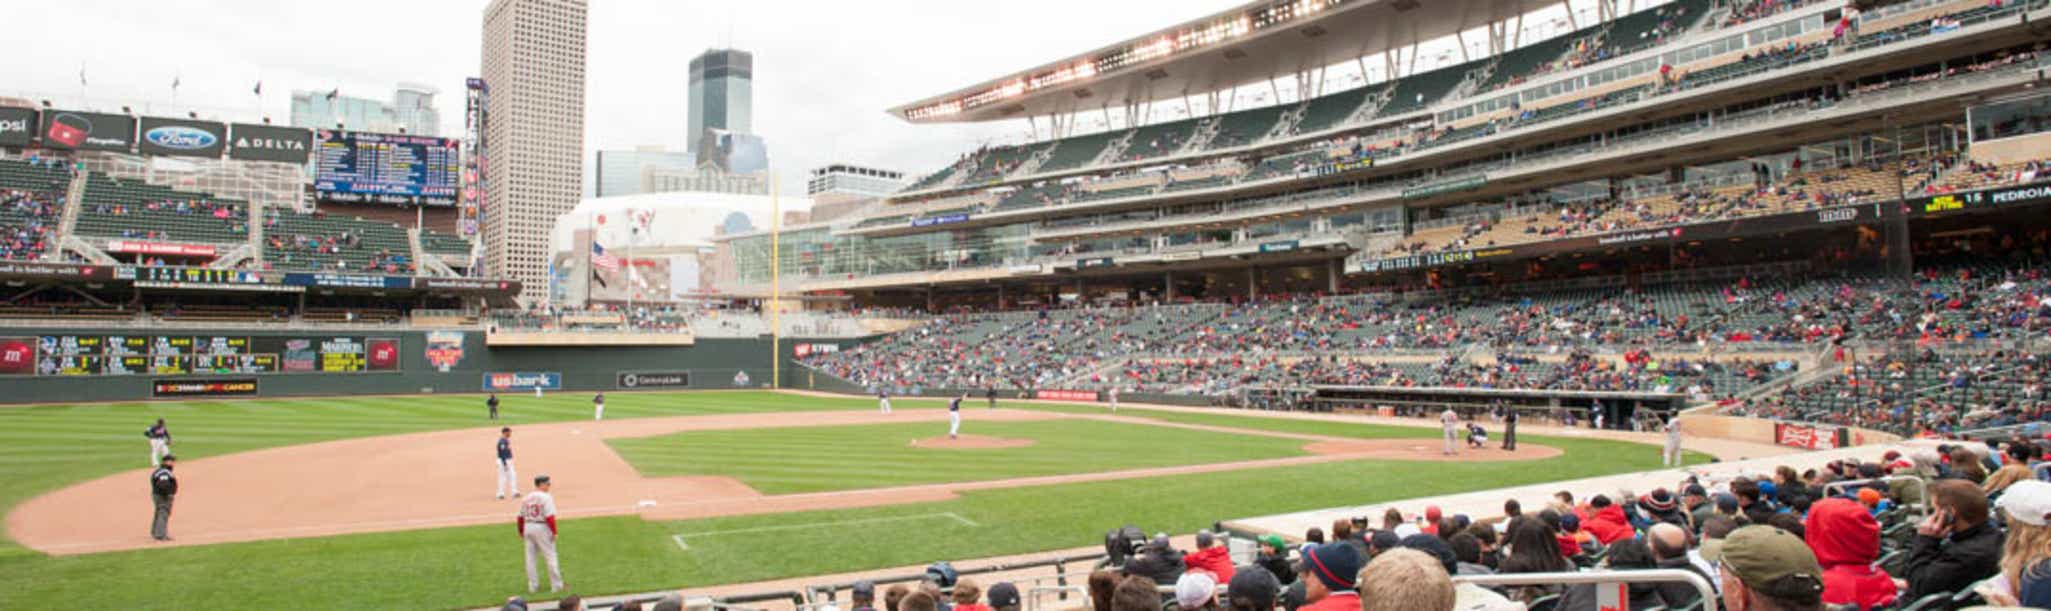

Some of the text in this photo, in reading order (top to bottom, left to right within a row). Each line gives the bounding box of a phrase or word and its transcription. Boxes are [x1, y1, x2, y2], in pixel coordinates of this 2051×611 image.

[158, 132, 202, 147] Ford
[253, 135, 304, 151] DELTA
[1966, 187, 2051, 203] 15 PEDROIA
[640, 376, 681, 385] CenturyLink
